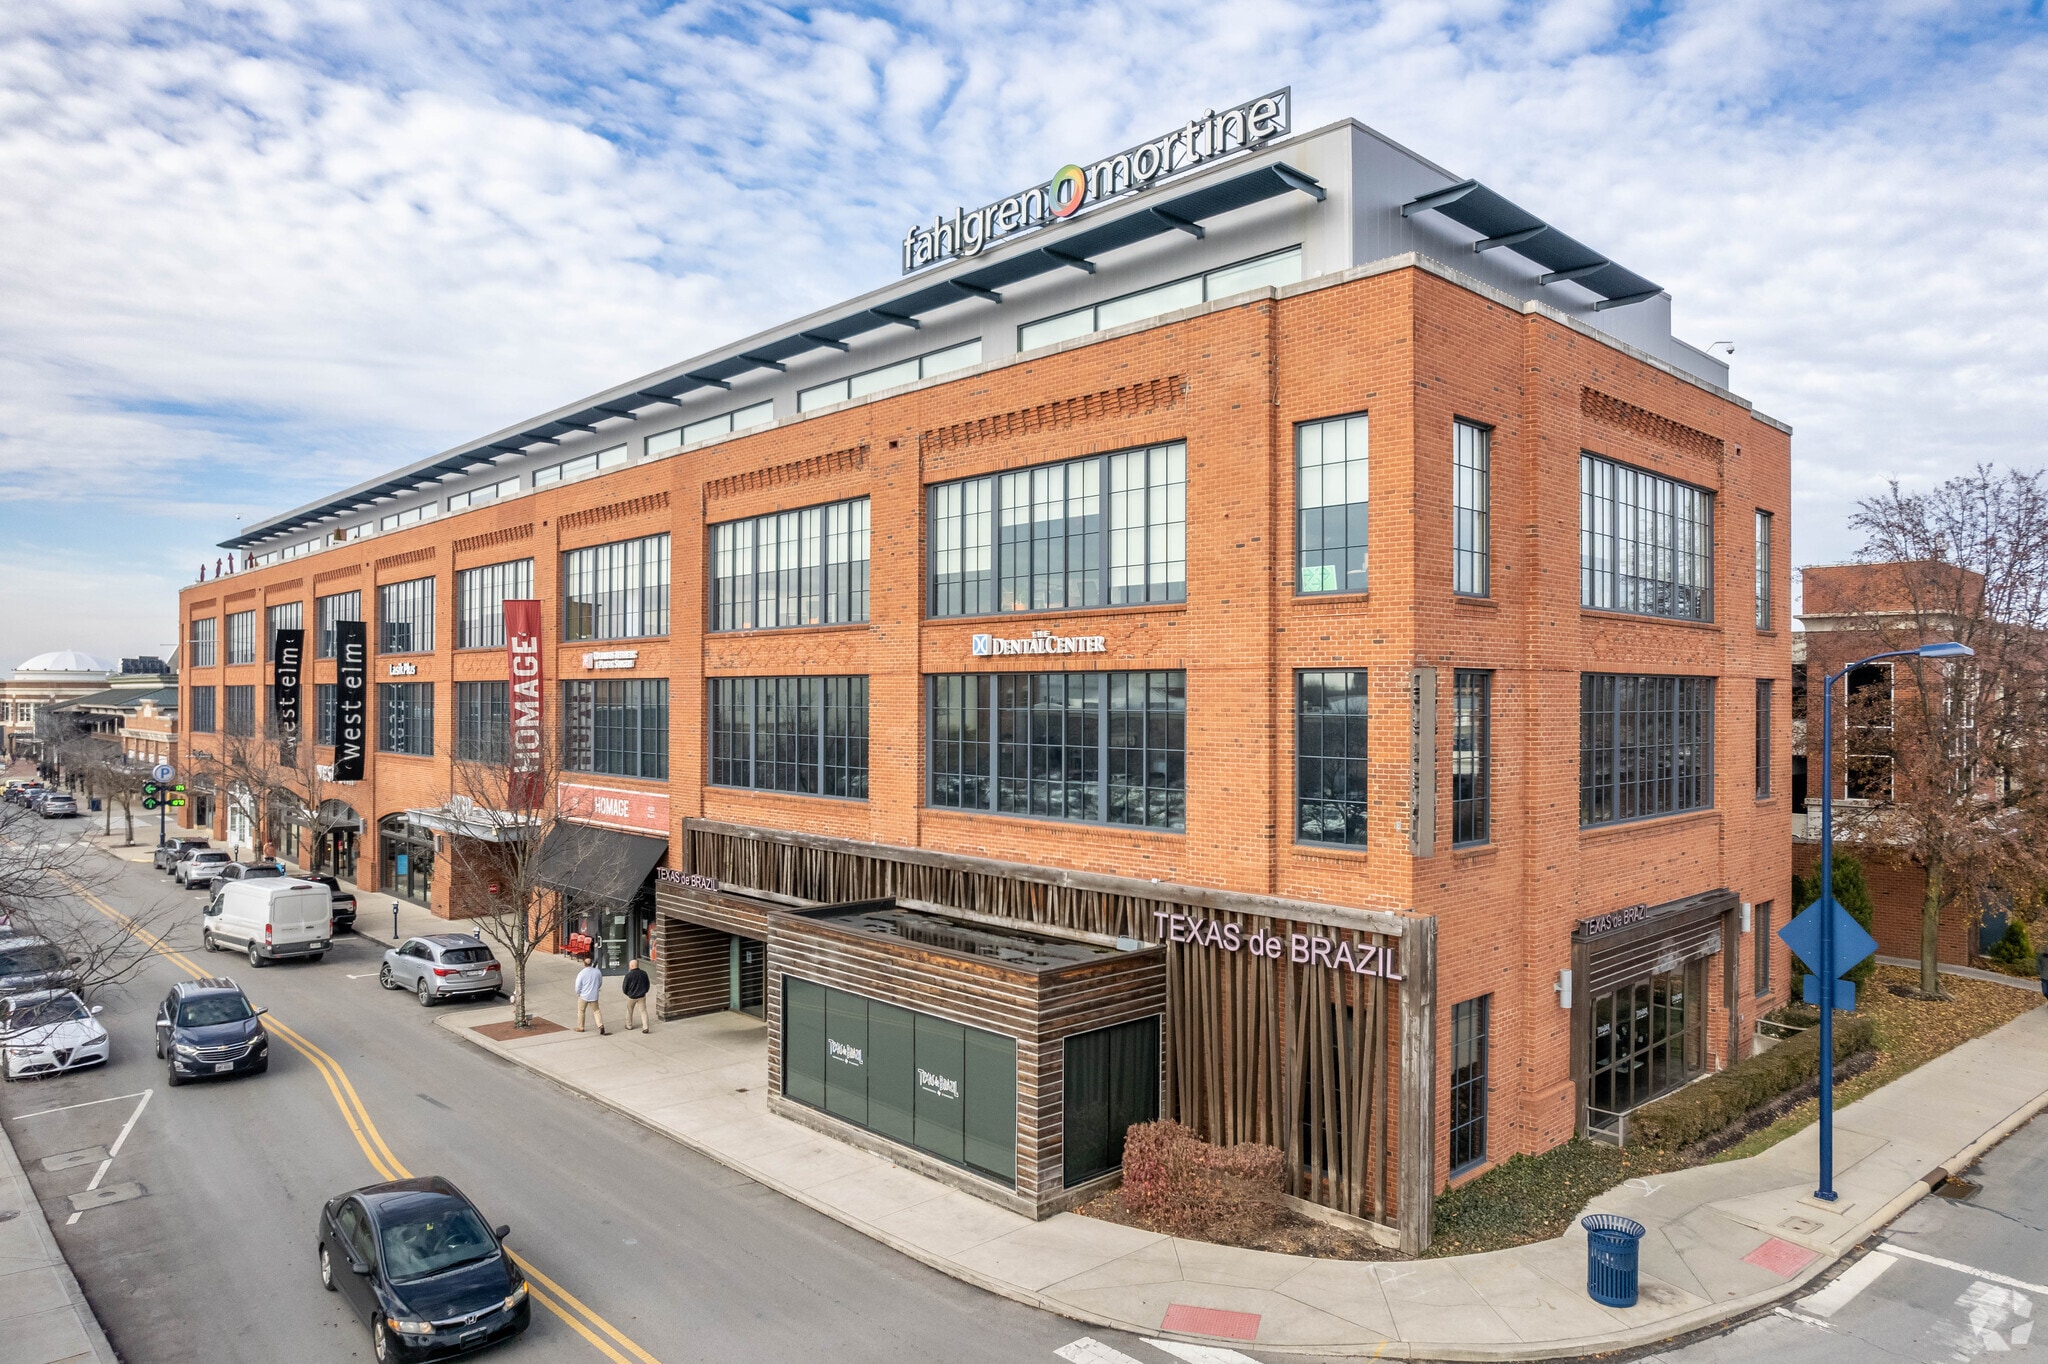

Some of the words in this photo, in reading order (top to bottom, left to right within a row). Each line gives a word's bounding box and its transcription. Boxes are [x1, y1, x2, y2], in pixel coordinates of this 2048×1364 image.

[903, 187, 1045, 269] fahlgren
[1090, 97, 1280, 199] mortine
[278, 647, 299, 687] elm
[341, 643, 363, 689] elm
[511, 636, 540, 773] HOMAGE
[341, 700, 362, 760] west
[161, 768, 170, 779] P
[594, 796, 630, 818] HOMAGE
[656, 867, 680, 883] TEXAS
[681, 873, 690, 886] de
[691, 875, 718, 892] BRAZIL
[1584, 914, 1612, 936] TEXAS
[1612, 913, 1622, 928] de
[1623, 904, 1650, 925] BRAZIL
[1153, 911, 1244, 952] TEXAS
[1249, 928, 1285, 959] de
[1291, 933, 1403, 981] BRAZIL
